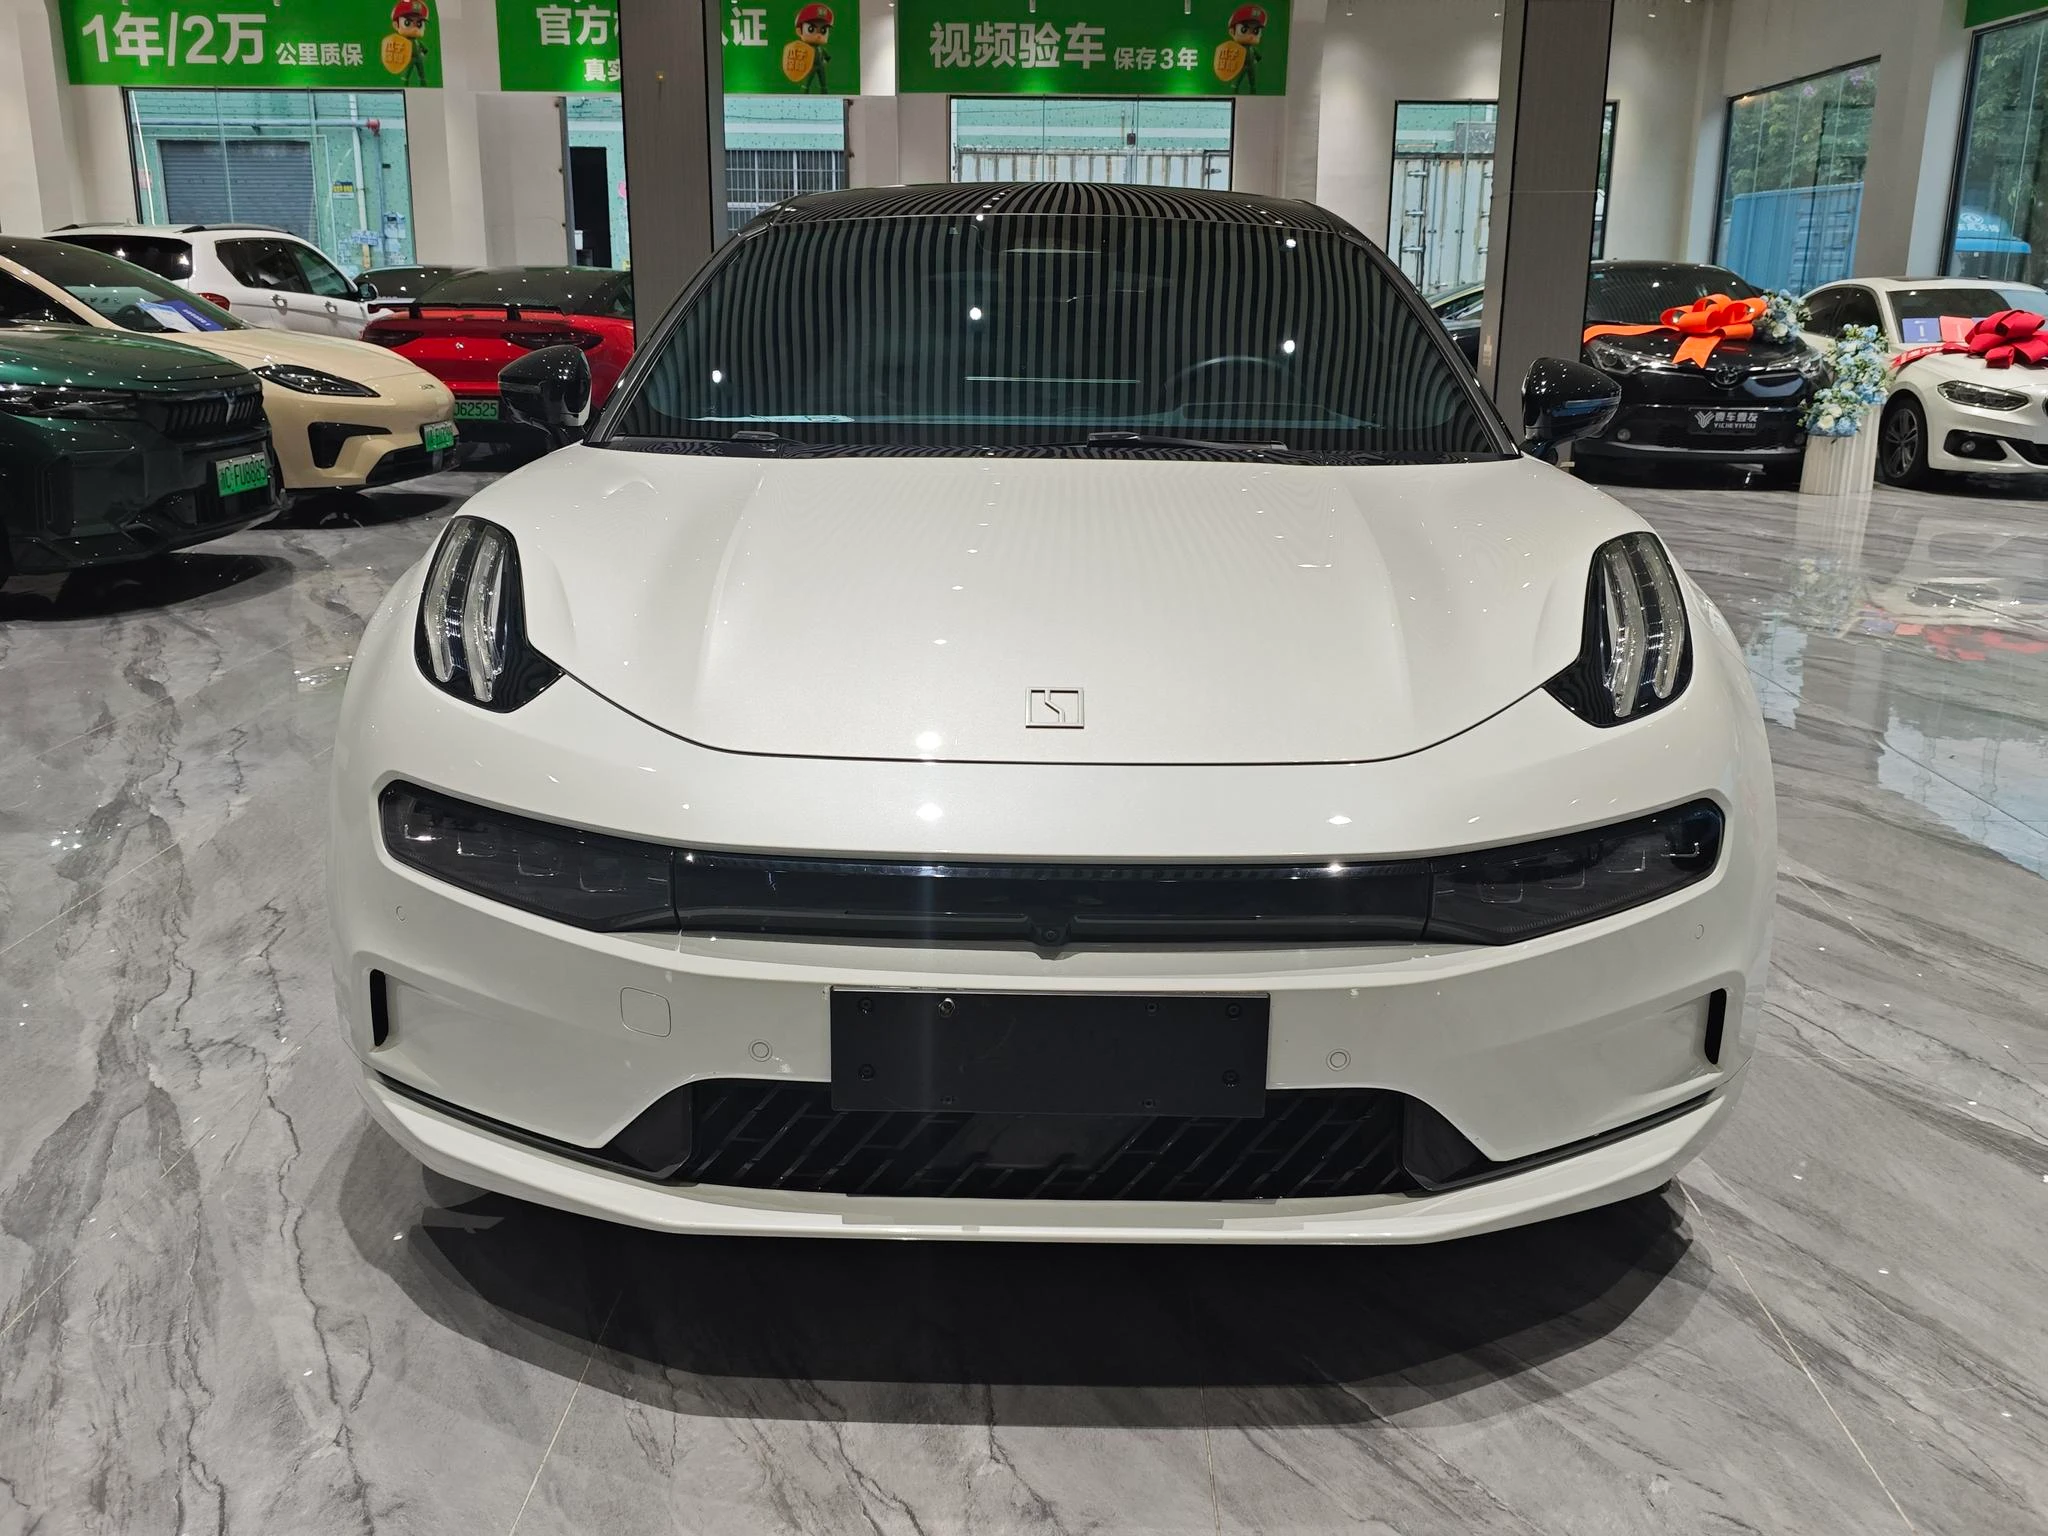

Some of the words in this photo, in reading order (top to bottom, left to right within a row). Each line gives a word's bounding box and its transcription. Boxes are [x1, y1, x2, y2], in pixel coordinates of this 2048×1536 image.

[82, 12, 267, 66] 1年/2万
[276, 42, 364, 66] 公里质保
[536, 4, 619, 46] 官方
[721, 6, 768, 46] 证
[929, 21, 1106, 69] 视频验车
[1114, 47, 1199, 71] 保存3年
